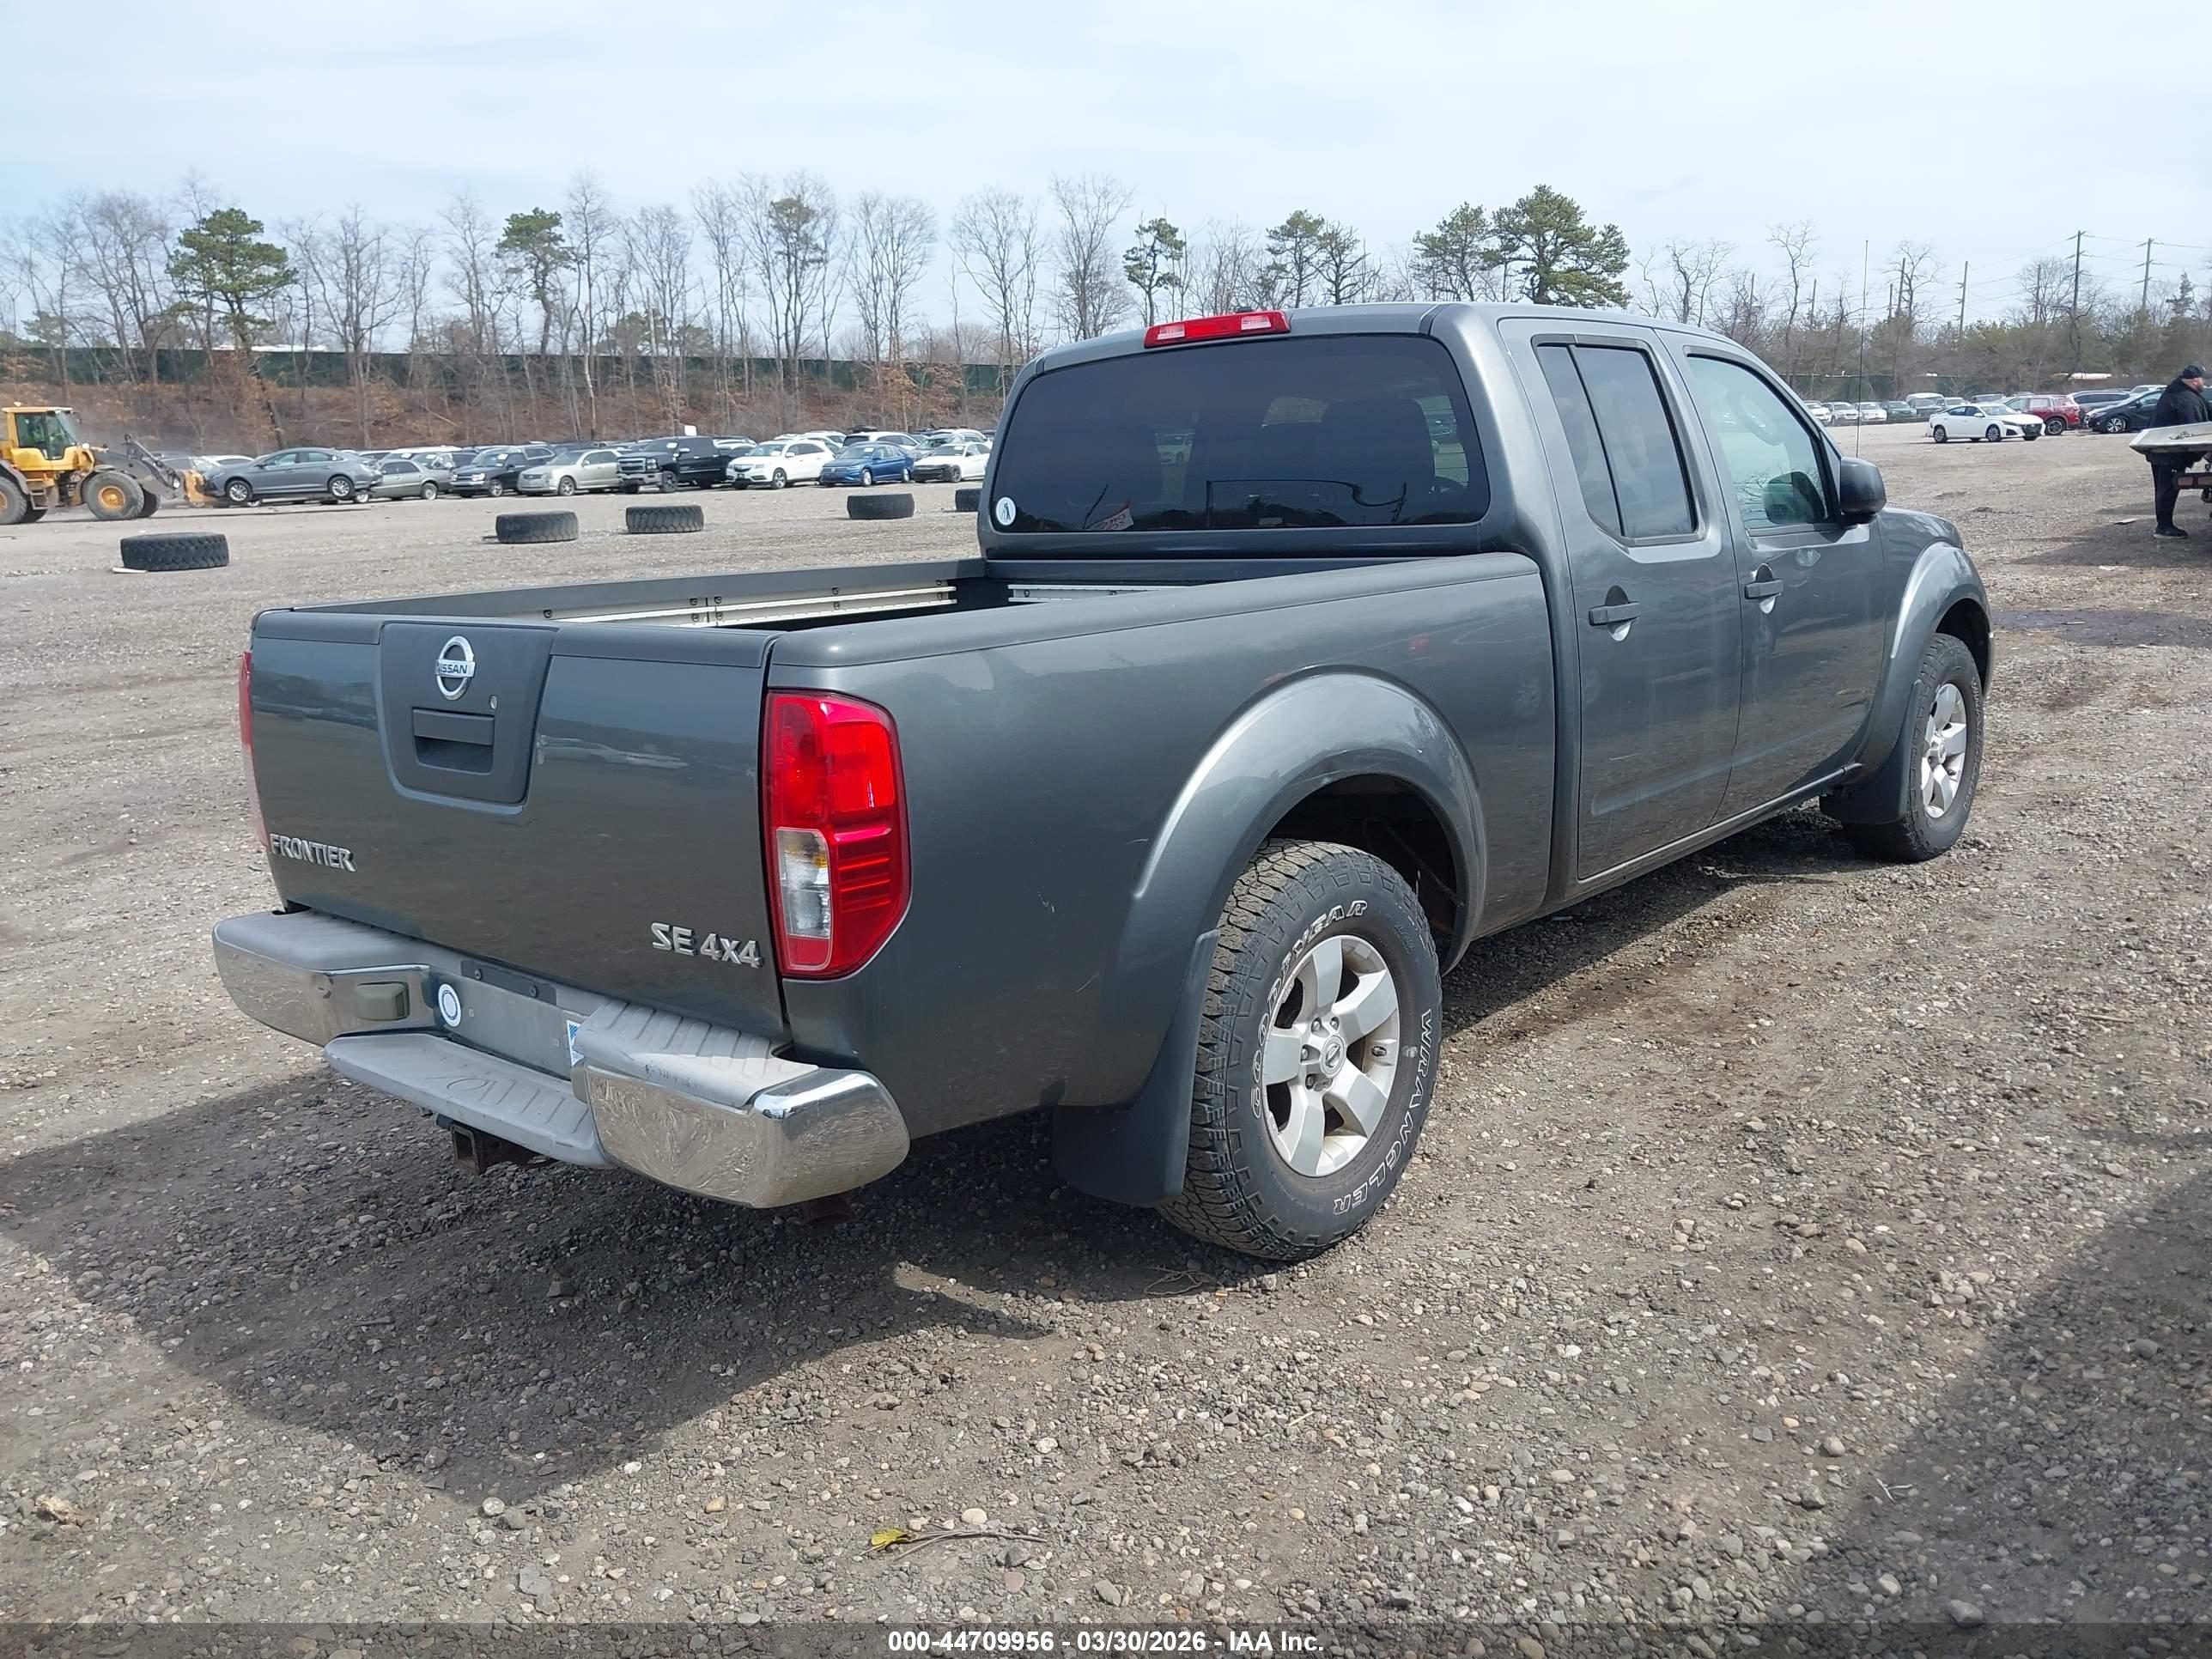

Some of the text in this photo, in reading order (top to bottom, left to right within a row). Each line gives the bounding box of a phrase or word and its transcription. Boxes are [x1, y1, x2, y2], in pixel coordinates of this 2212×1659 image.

[270, 833, 356, 872] FRONTIER
[651, 922, 696, 957] SE
[1250, 900, 1367, 1119] GOODYEAR
[1333, 1008, 1432, 1216] WRANGLER
